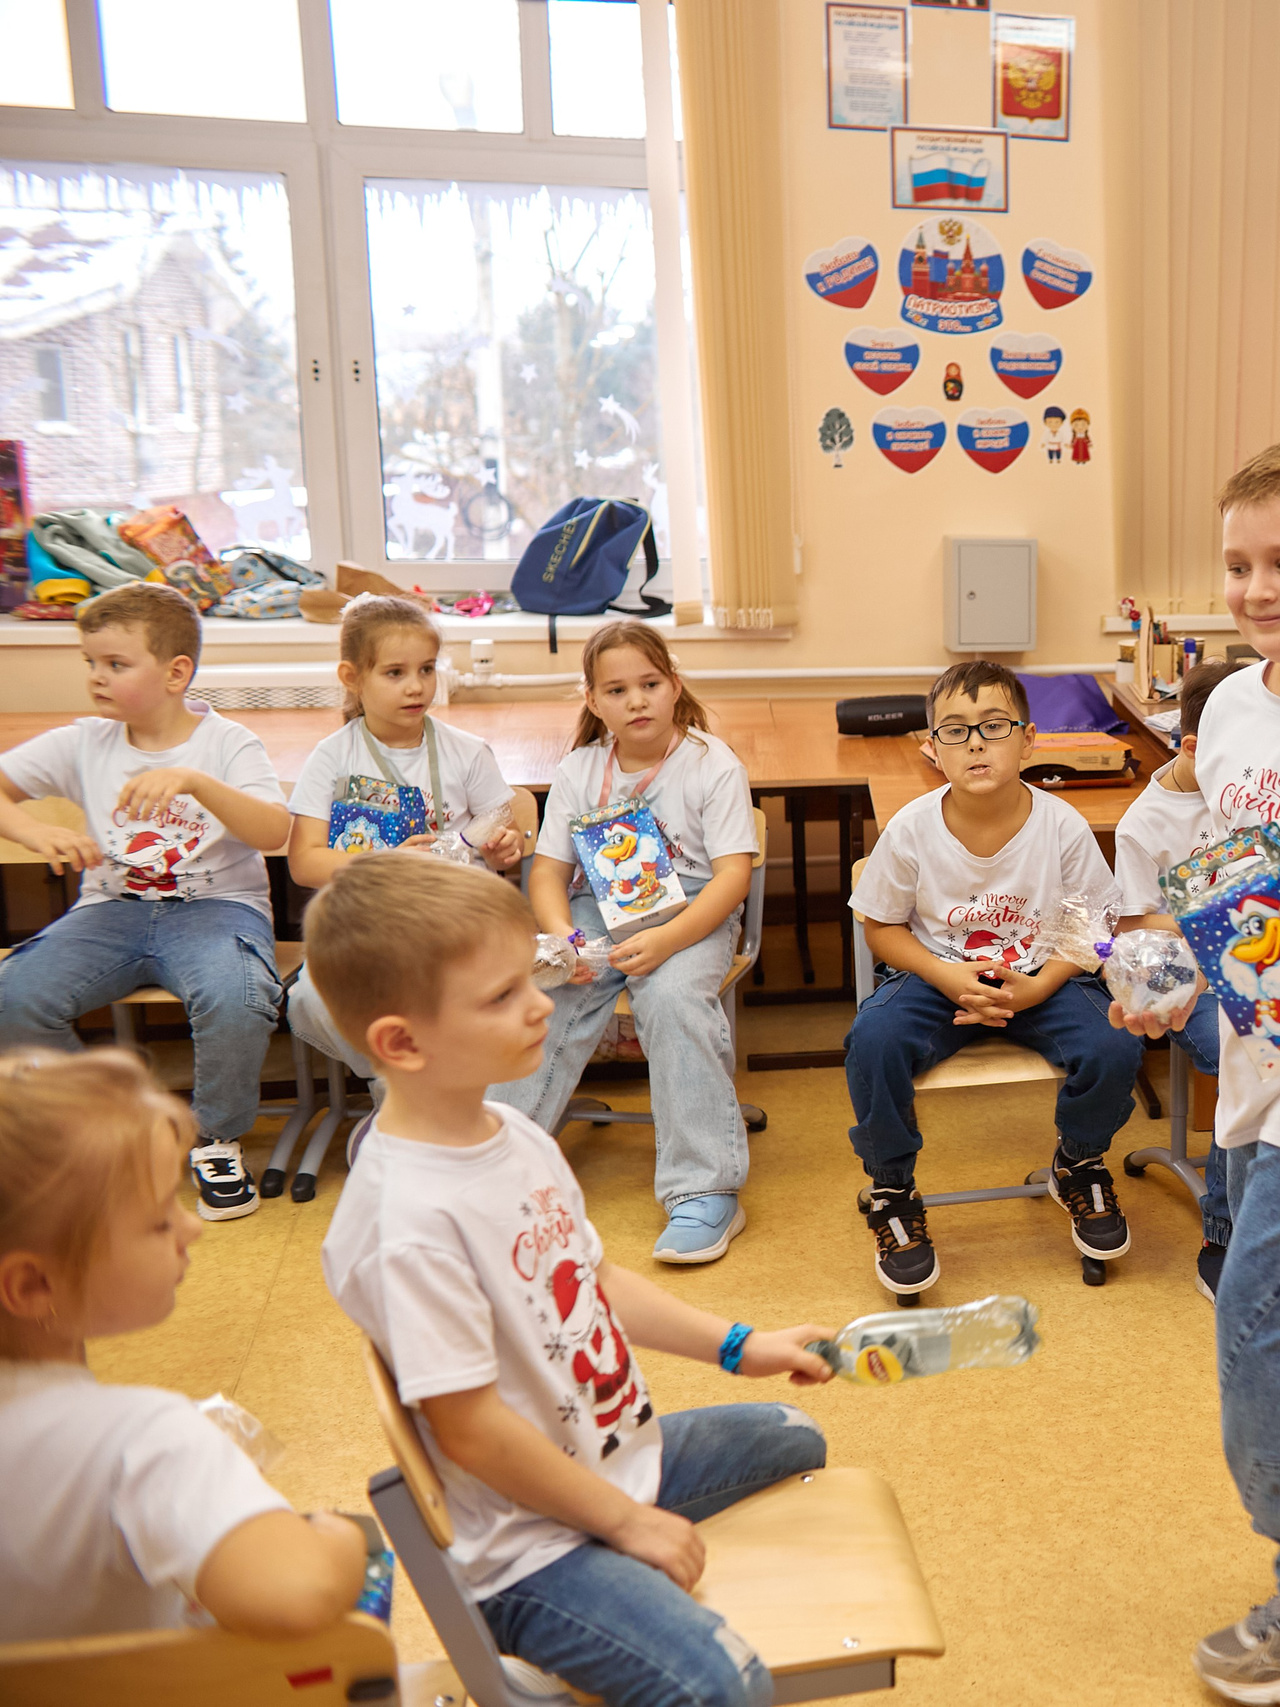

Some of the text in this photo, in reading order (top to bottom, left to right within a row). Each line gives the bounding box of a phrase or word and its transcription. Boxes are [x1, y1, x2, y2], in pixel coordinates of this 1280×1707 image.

[542, 517, 578, 583] SKECHE
[981, 893, 1027, 910] Merry
[947, 904, 1046, 935] Christmas
